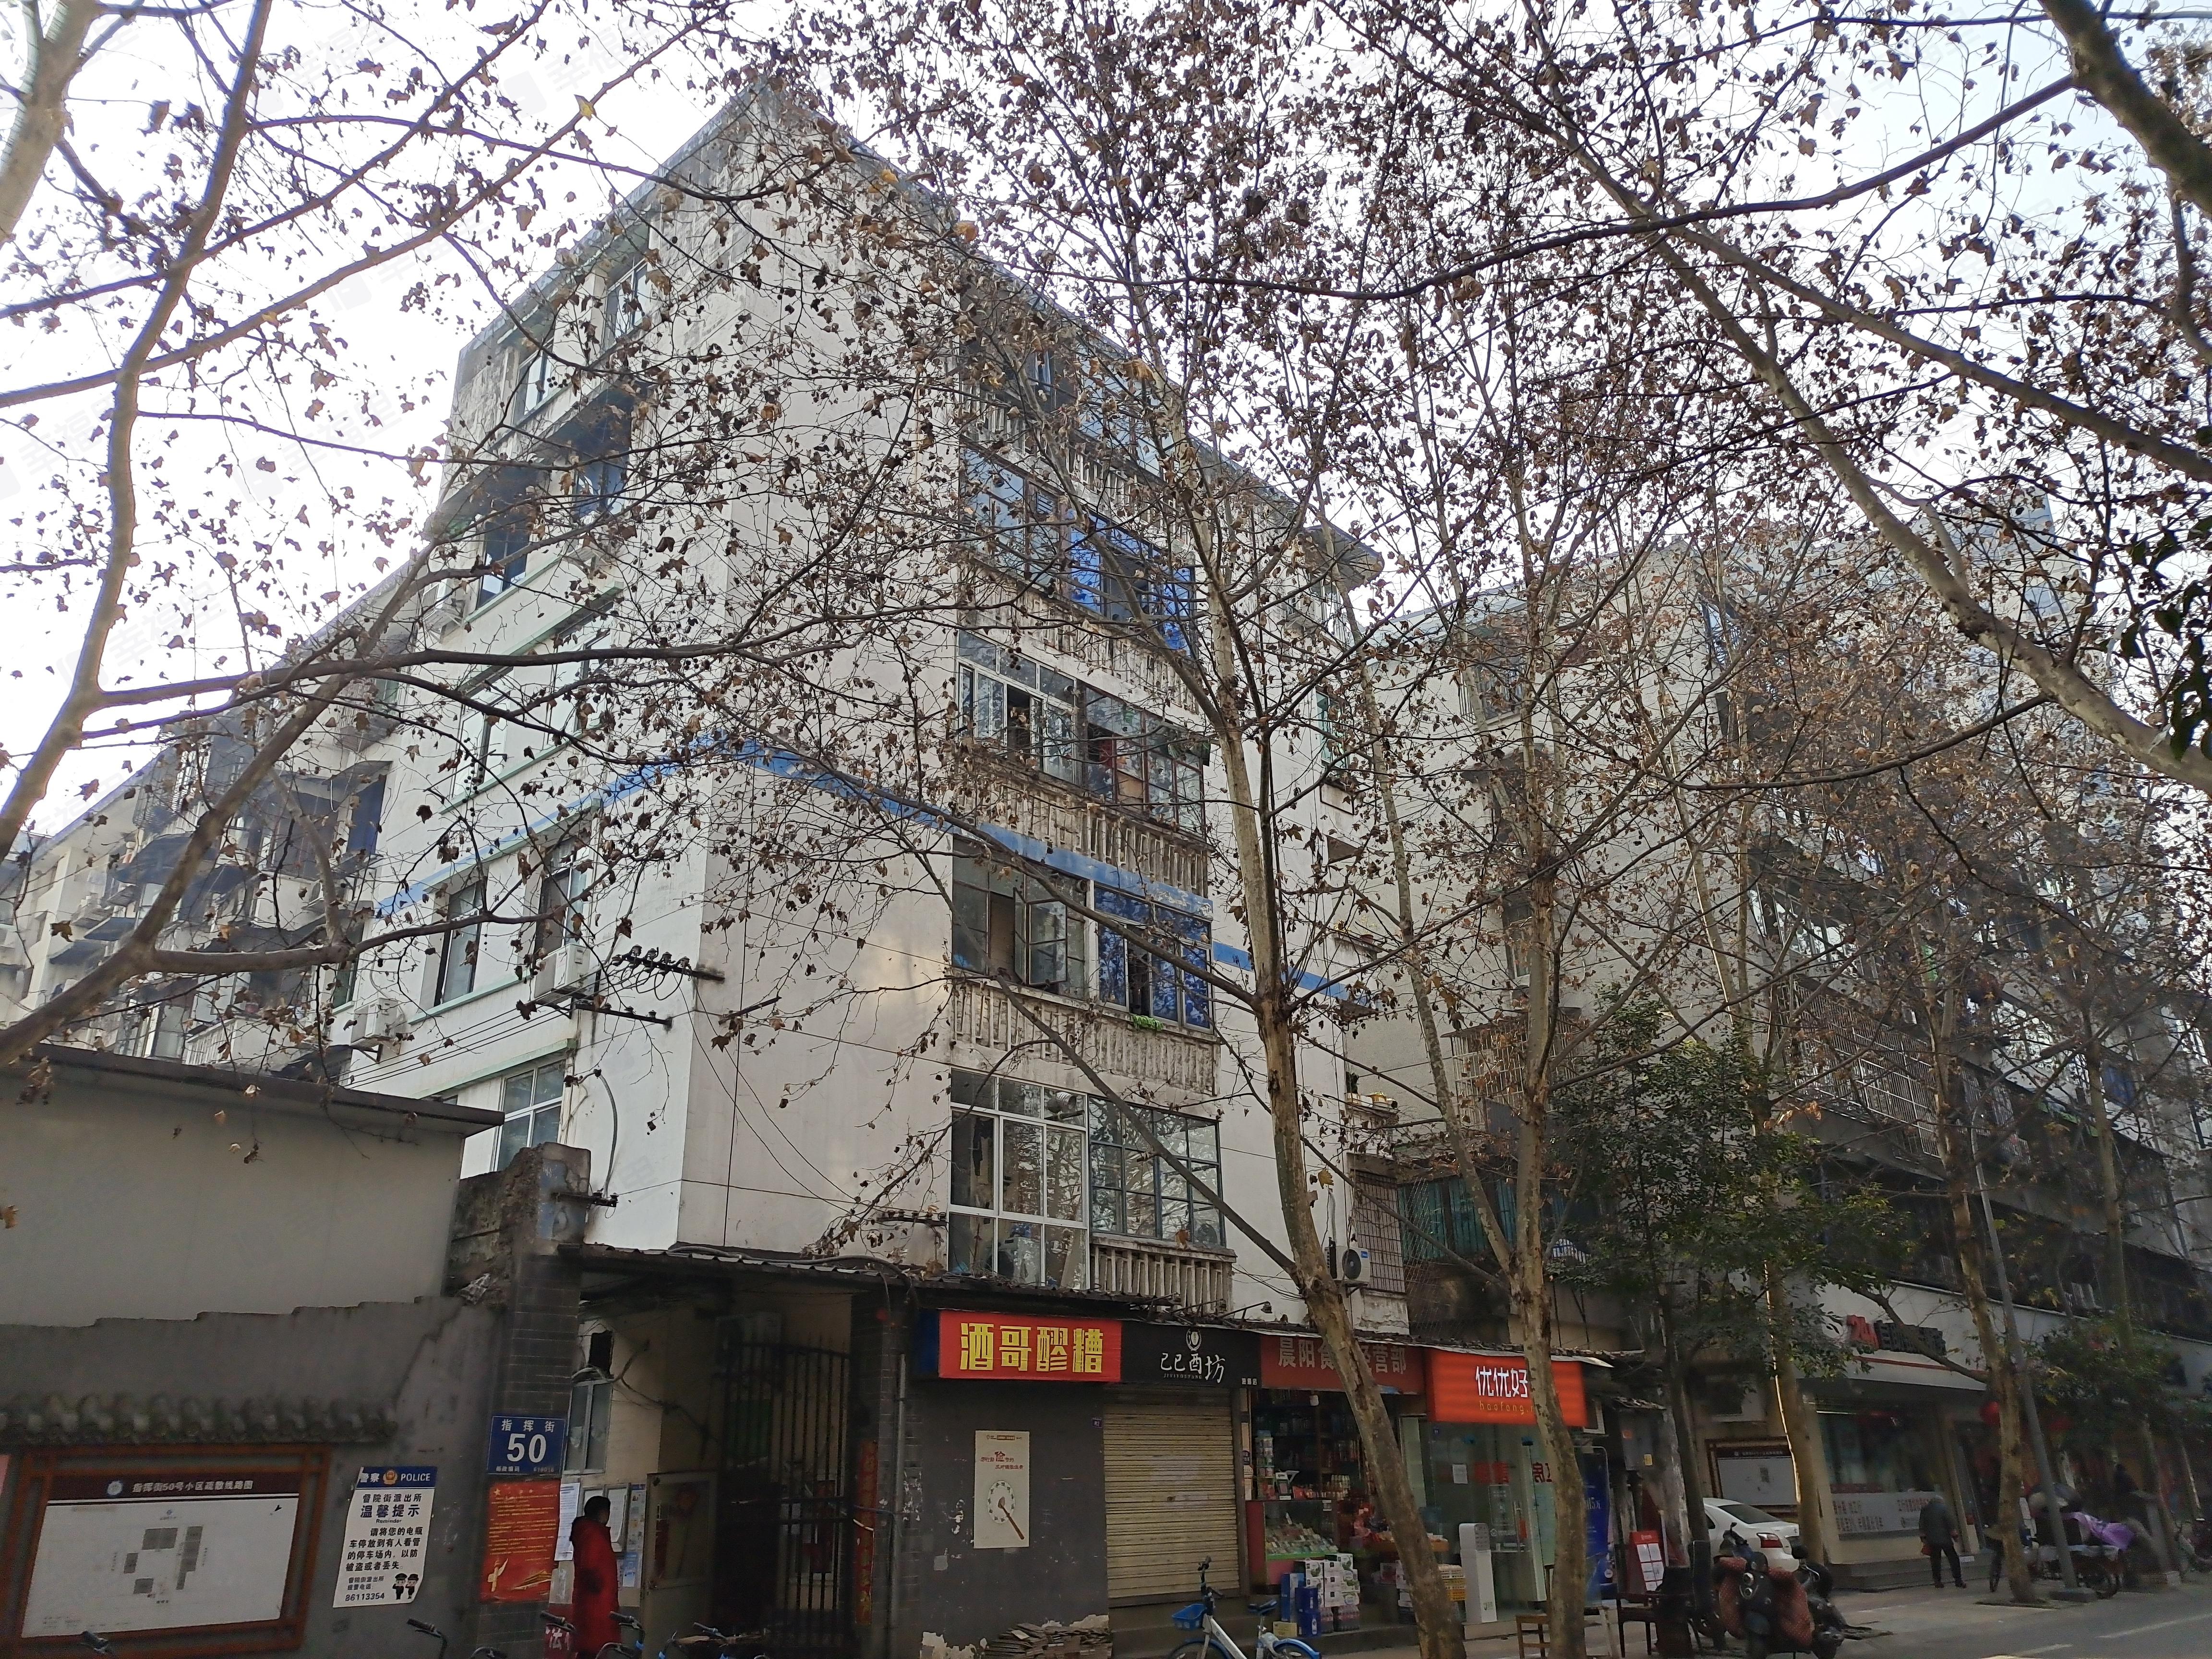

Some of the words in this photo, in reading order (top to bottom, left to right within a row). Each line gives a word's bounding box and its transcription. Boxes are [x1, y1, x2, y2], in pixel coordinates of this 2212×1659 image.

[960, 1323, 1104, 1373] 酒哥醪糟
[1278, 1337, 1407, 1374] 晨阳食营部
[501, 1419, 555, 1433] 指挥街
[507, 1433, 546, 1463] 50
[400, 1473, 431, 1481] POLICE
[363, 1493, 421, 1503] 督院街派出所
[361, 1504, 420, 1518] 温馨提示
[370, 1527, 423, 1537] 请将您的电瓶
[349, 1538, 421, 1548] 车停放到有人看管
[345, 1592, 385, 1601] 86113354
